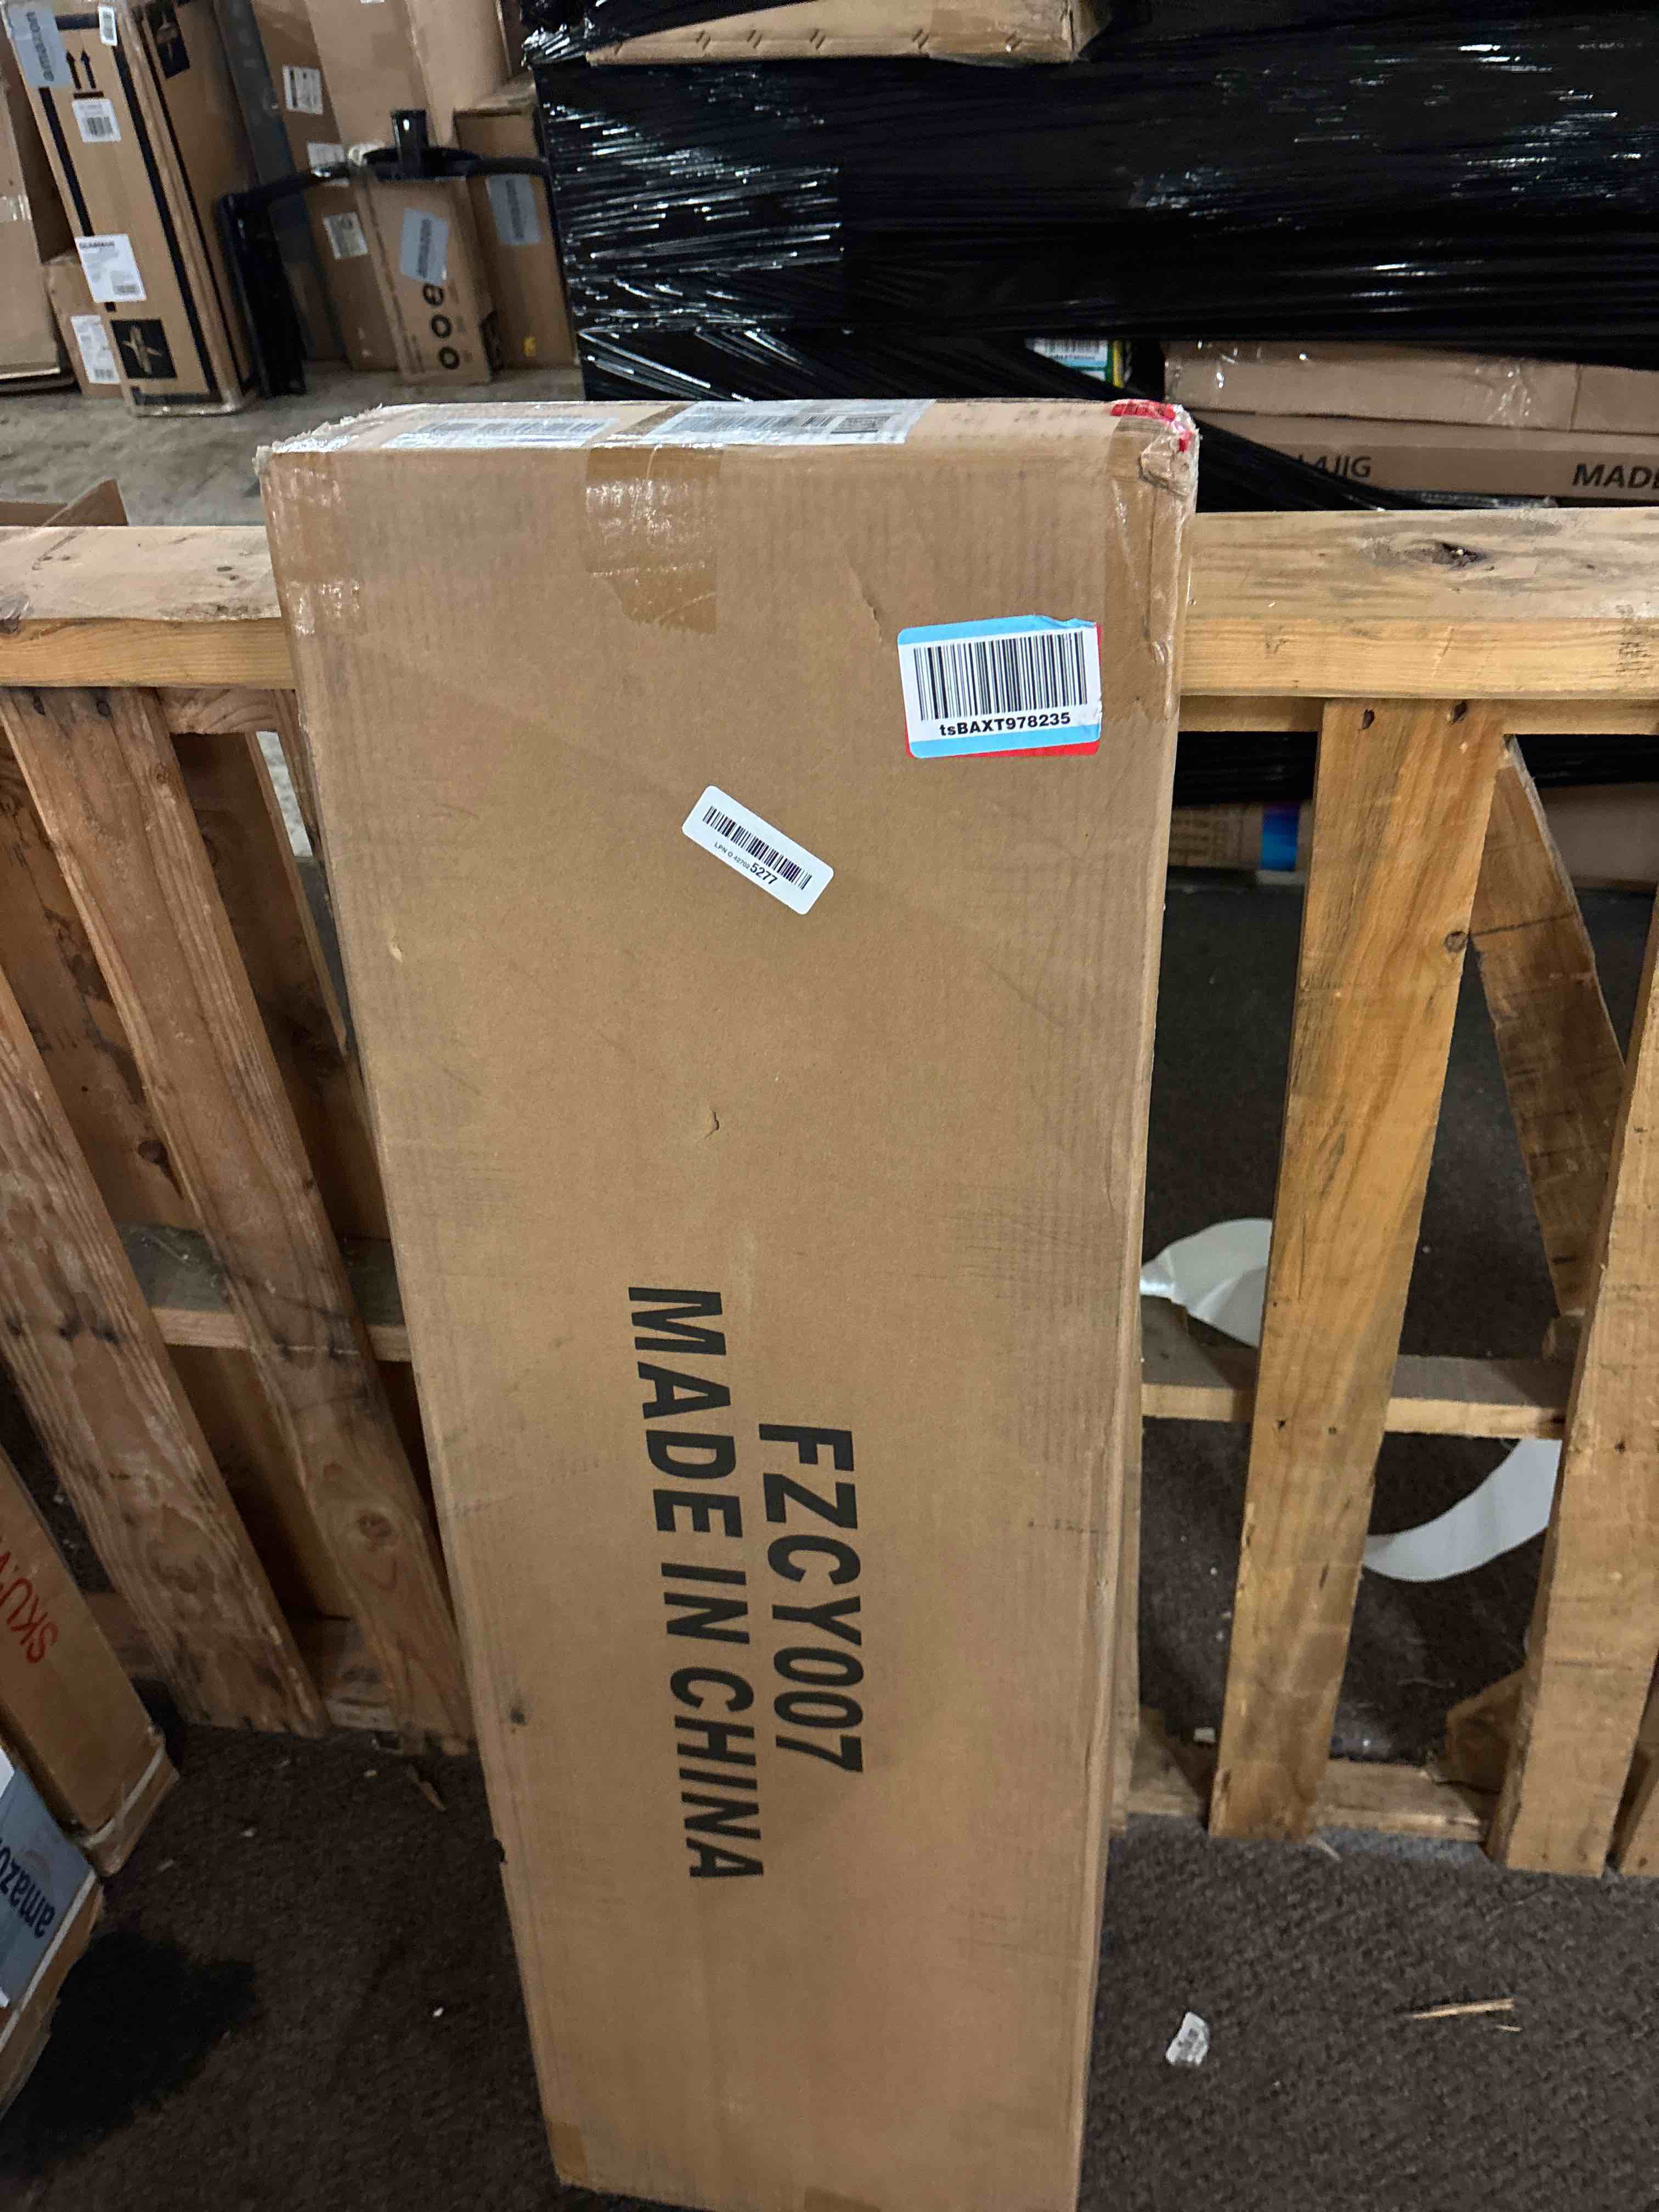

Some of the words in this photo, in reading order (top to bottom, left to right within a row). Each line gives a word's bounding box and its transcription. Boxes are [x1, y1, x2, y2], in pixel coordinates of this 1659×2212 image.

[939, 712, 1071, 736] tsBAXT978235
[714, 842, 727, 853] LPN
[628, 1286, 743, 1538] MADE
[661, 1562, 751, 1645] IN
[758, 1423, 864, 1773] FZCY007
[669, 1666, 764, 1878] CHINA
